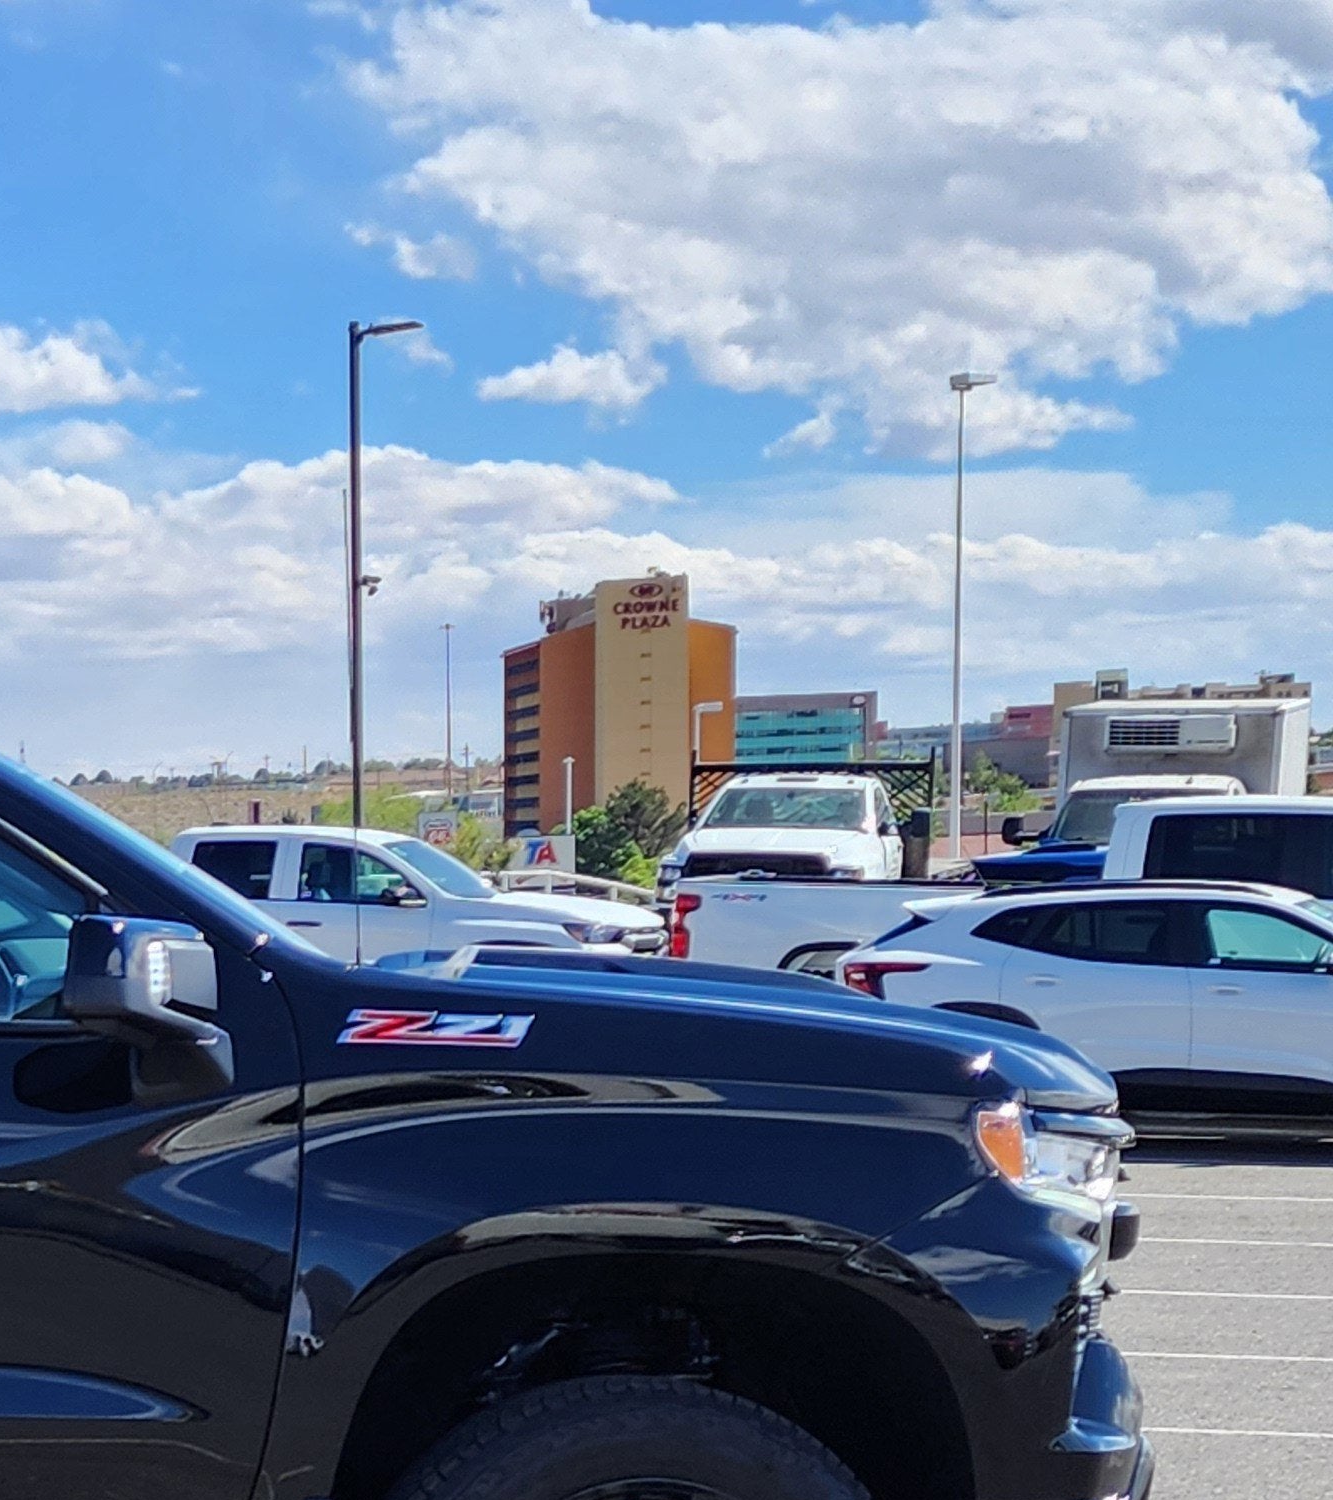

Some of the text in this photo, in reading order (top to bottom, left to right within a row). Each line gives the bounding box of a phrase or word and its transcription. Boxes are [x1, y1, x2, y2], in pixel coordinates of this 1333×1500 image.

[613, 599, 680, 615] CROWNE
[620, 614, 671, 630] PLAZA
[525, 839, 557, 865] TA
[336, 1009, 536, 1049] Z71
